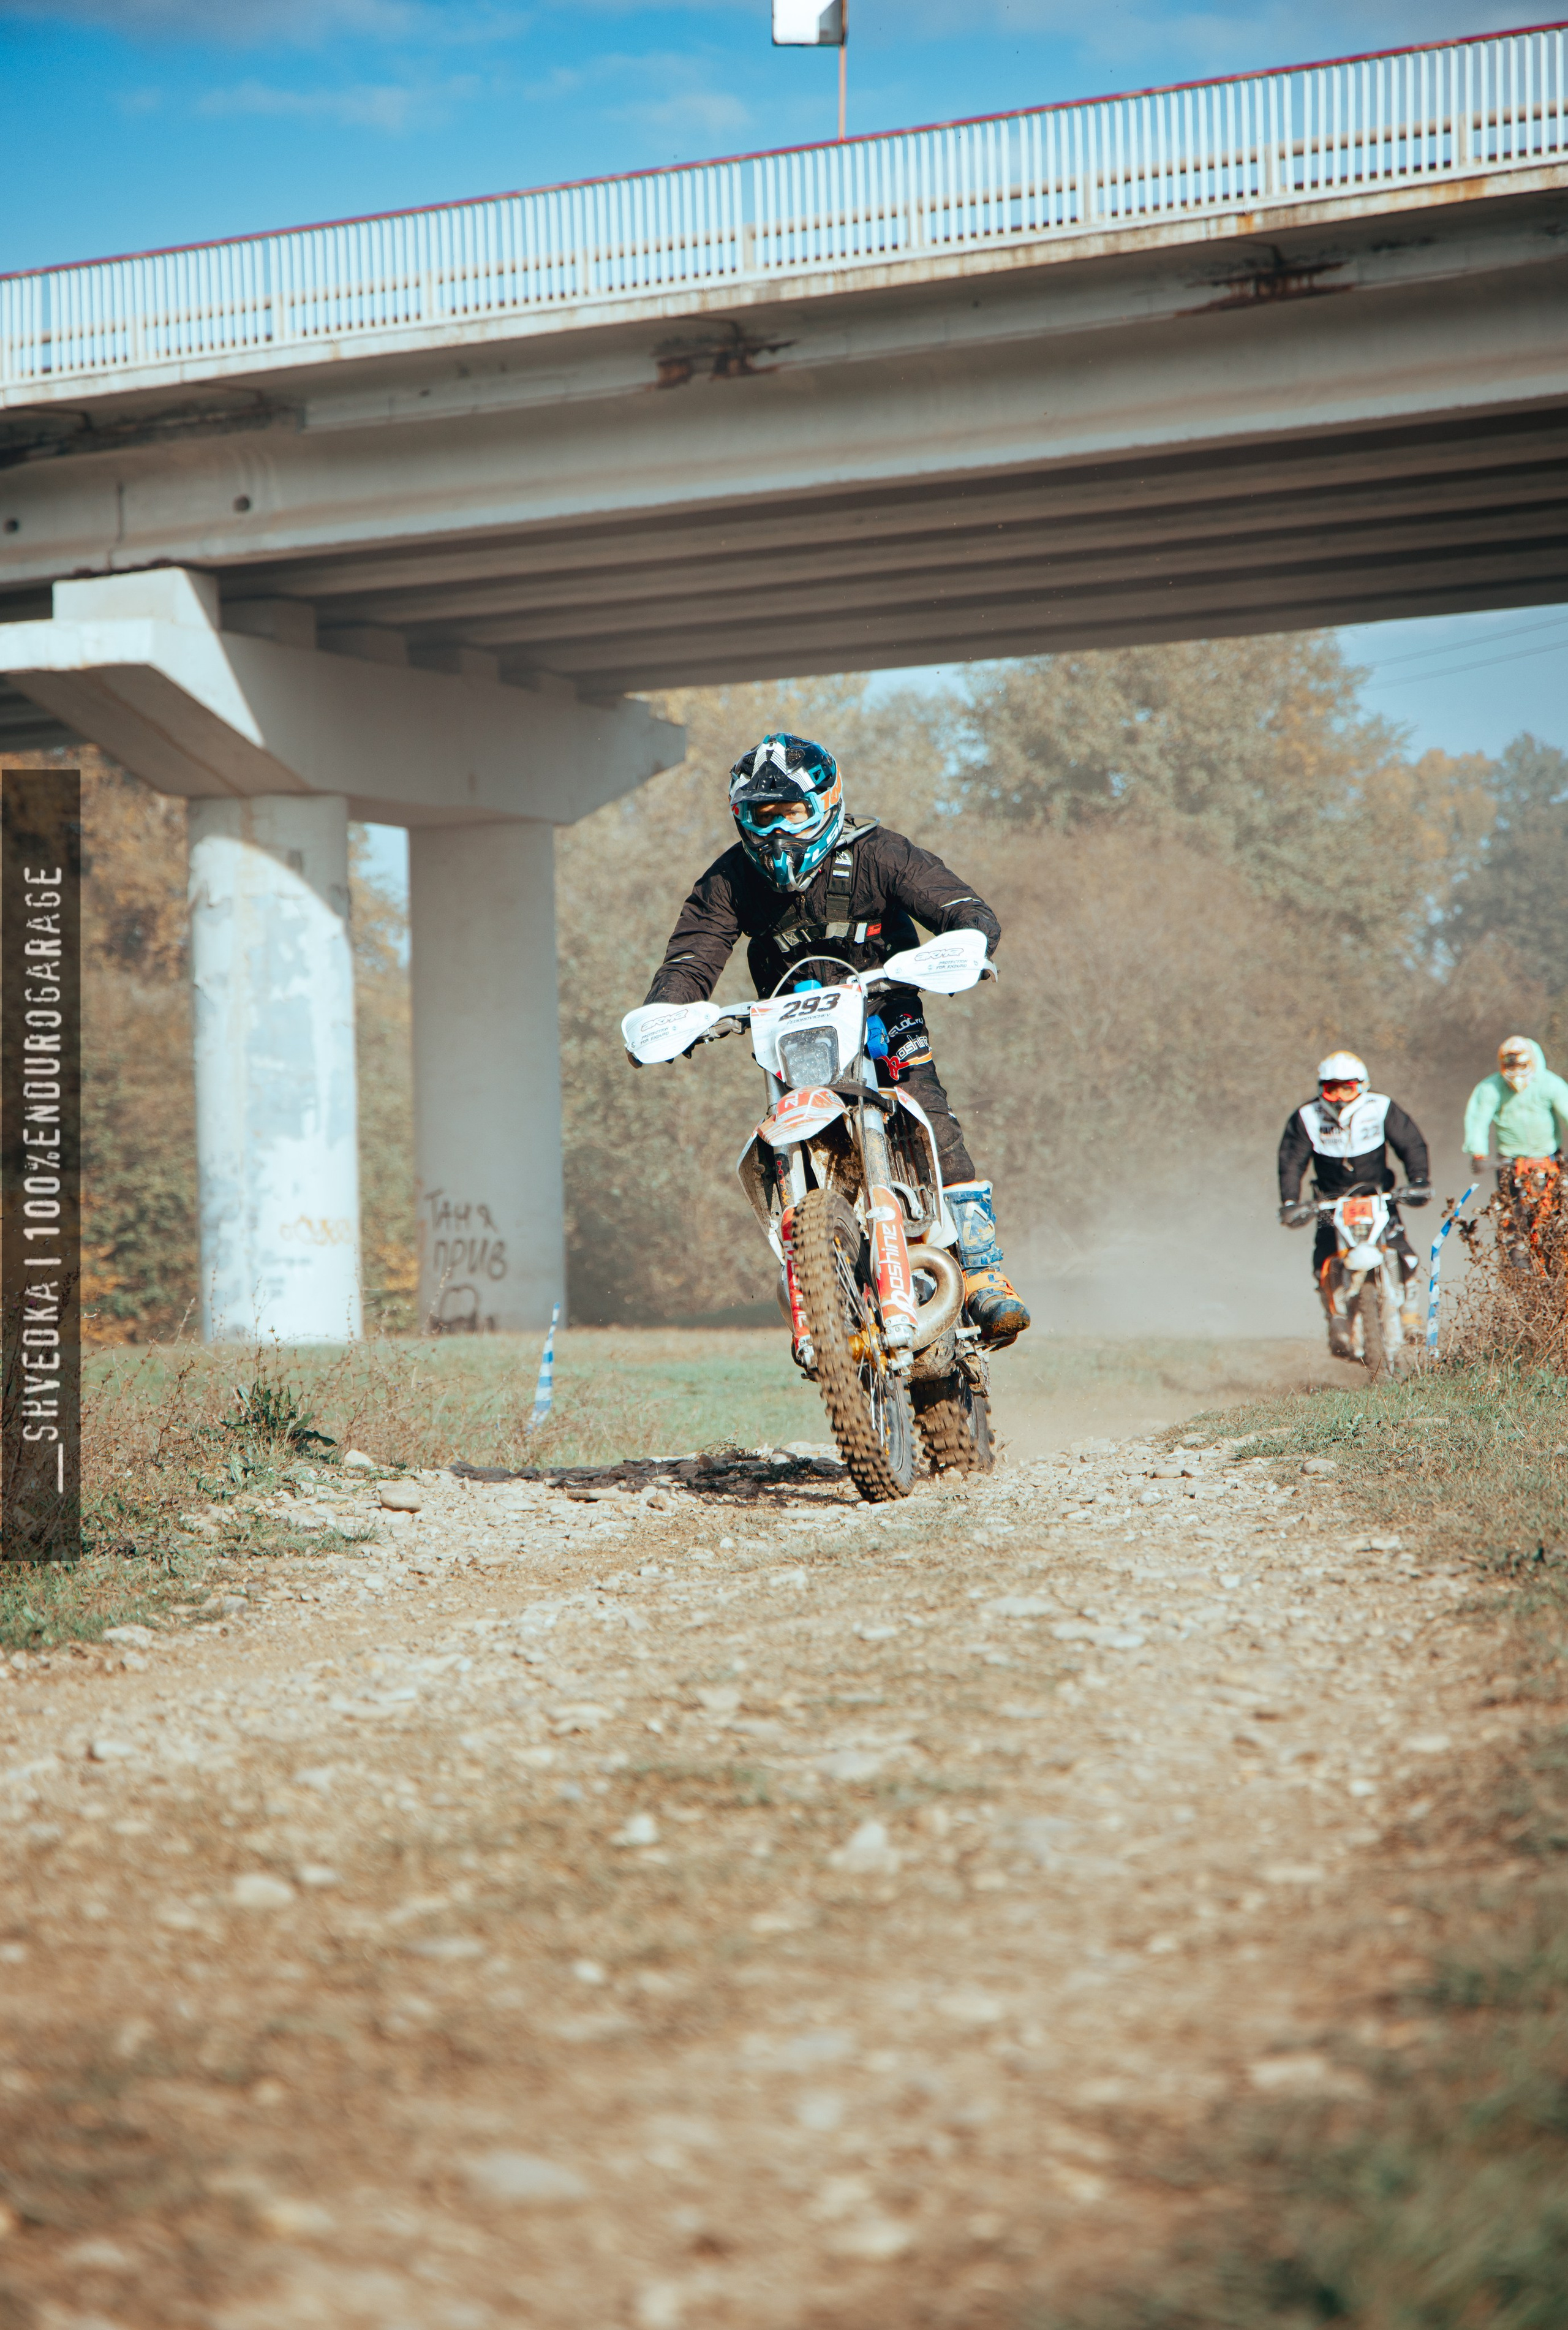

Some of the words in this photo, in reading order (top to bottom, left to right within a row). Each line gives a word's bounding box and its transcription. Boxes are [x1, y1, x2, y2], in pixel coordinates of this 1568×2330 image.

[778, 993, 842, 1023] 293
[641, 1027, 669, 1040] PROTECTION
[650, 1031, 670, 1042] ENDURO
